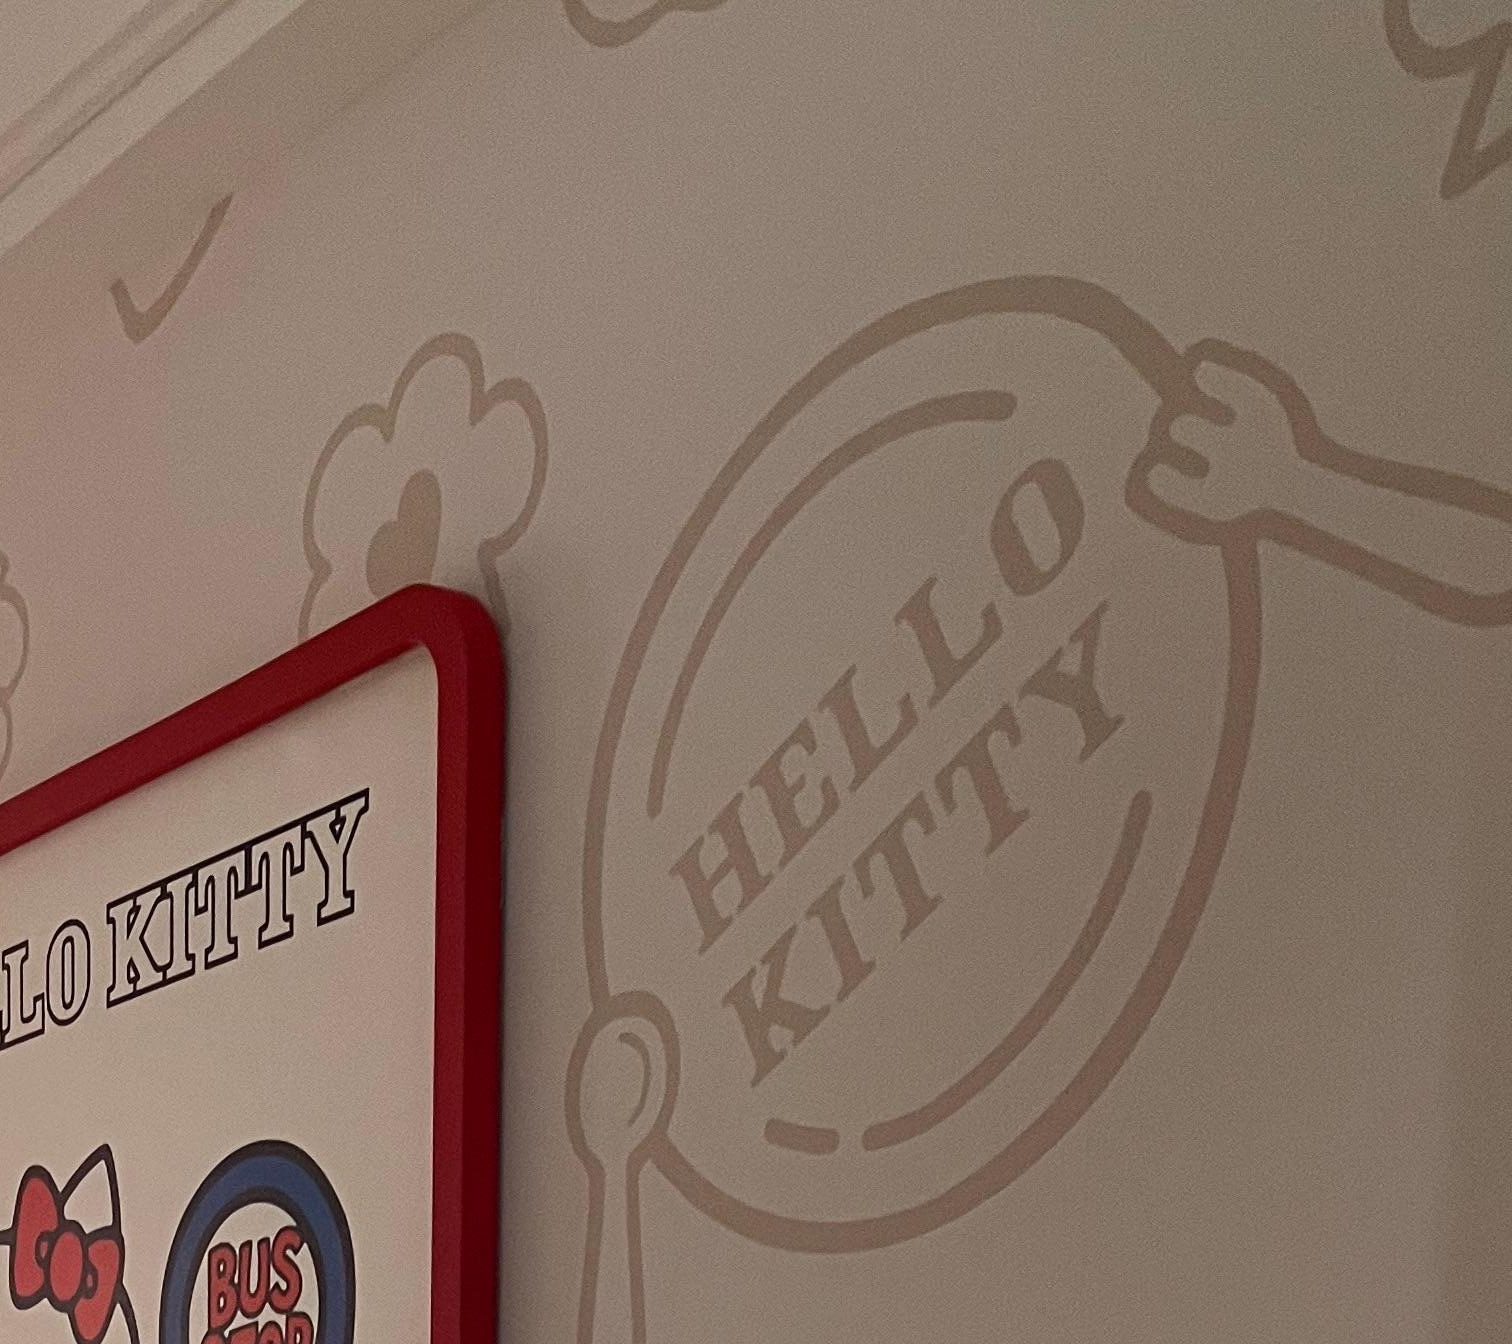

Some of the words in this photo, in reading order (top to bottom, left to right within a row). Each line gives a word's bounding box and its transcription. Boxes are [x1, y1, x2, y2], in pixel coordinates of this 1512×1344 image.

[668, 457, 1085, 955] HELLO
[722, 600, 1124, 1087] KITTY
[106, 788, 370, 1008] KITTY
[207, 1225, 305, 1330] BUS
